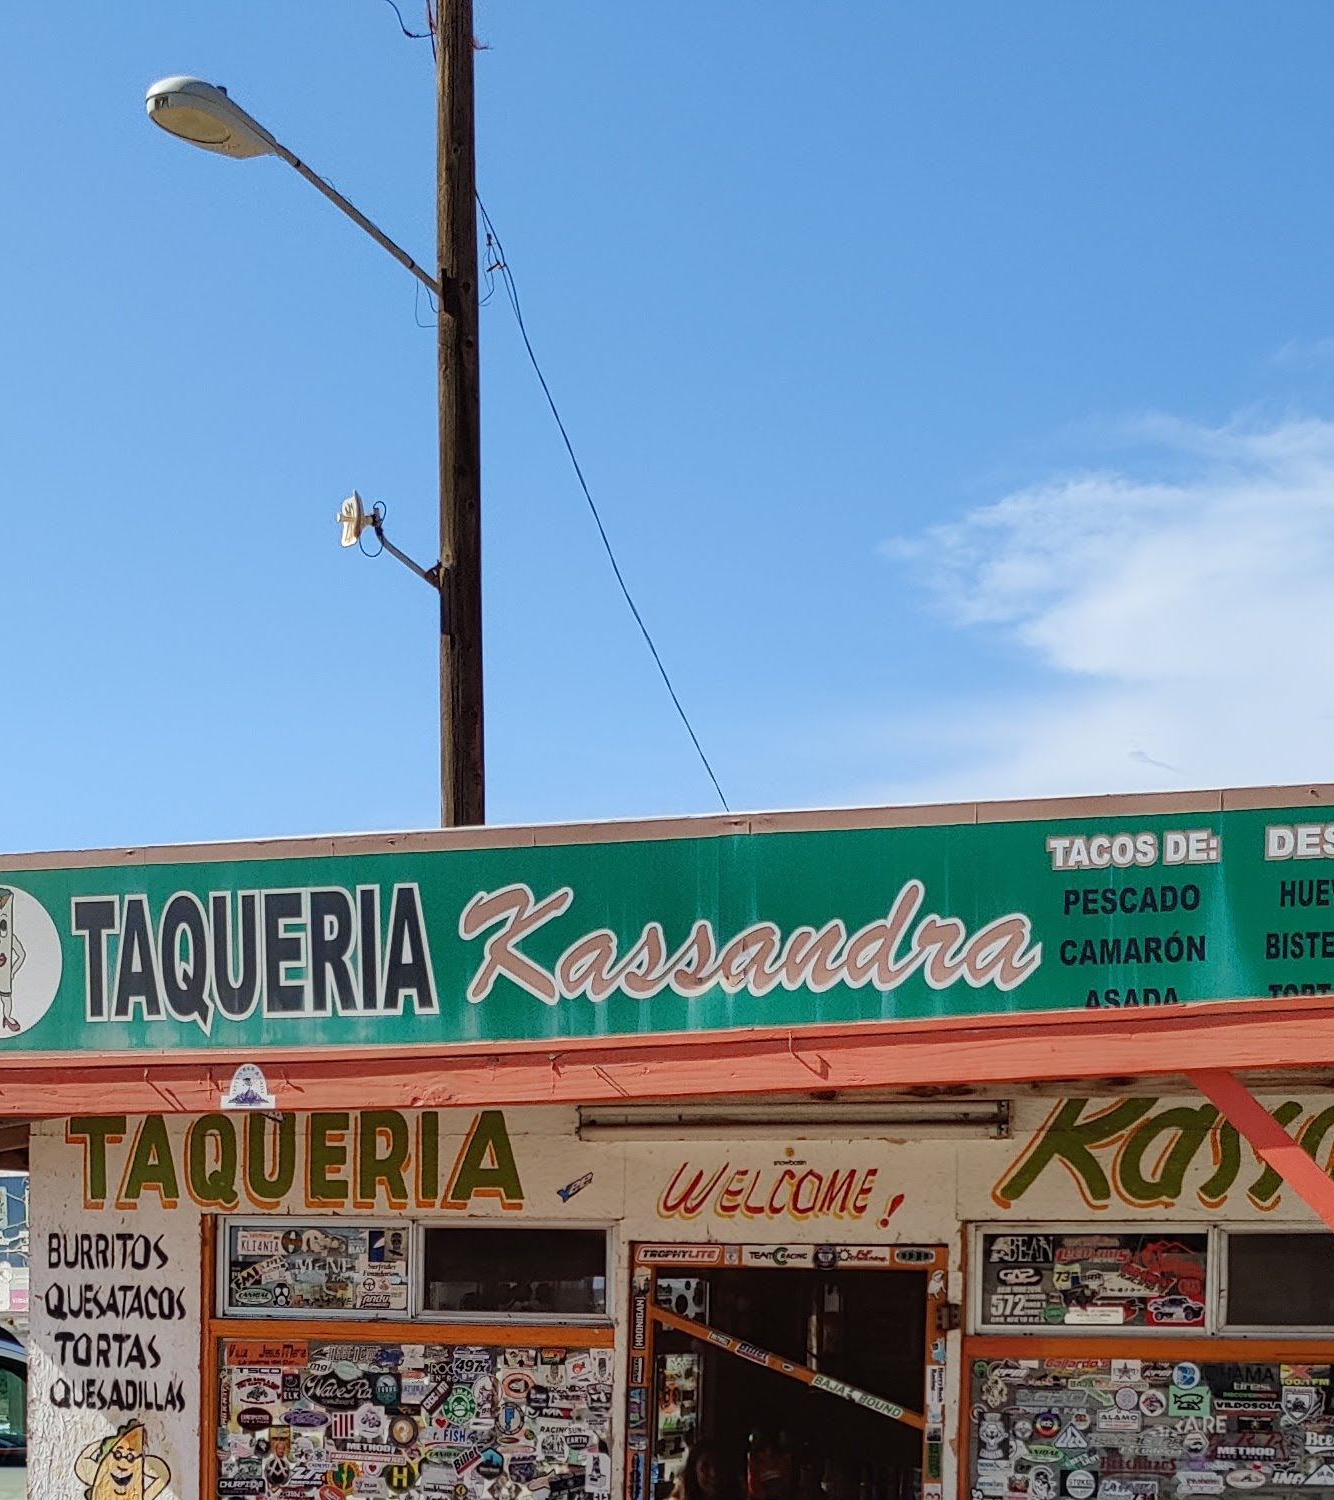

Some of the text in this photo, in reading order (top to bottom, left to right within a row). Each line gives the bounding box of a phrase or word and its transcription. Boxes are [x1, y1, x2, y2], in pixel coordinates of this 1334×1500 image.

[1048, 829, 1220, 870] TACOS DE:
[1063, 884, 1201, 916] PESCADO
[71, 878, 1043, 1037] TAQUERIA Kassandra
[1059, 930, 1206, 966] CAMARÓN
[67, 1110, 524, 1210] TAQUERIA
[48, 1233, 169, 1270] BURRITOS
[643, 1250, 716, 1259] TROPHYLITE
[781, 1252, 808, 1260] RACING
[1008, 1236, 1053, 1262] BEAN
[44, 1282, 187, 1321] QUESATACOS
[990, 1294, 1025, 1316] 572
[54, 1332, 161, 1370] TORTAS
[49, 1379, 186, 1414] QUESADILLAS
[283, 1392, 300, 1400] ELK
[814, 1376, 902, 1418] BAJA BOUND
[1216, 1401, 1282, 1410] VILDOSOLA
[540, 1426, 569, 1434] RACIN
[347, 1442, 390, 1452] METHOD
[1217, 1446, 1275, 1457] METHOD
